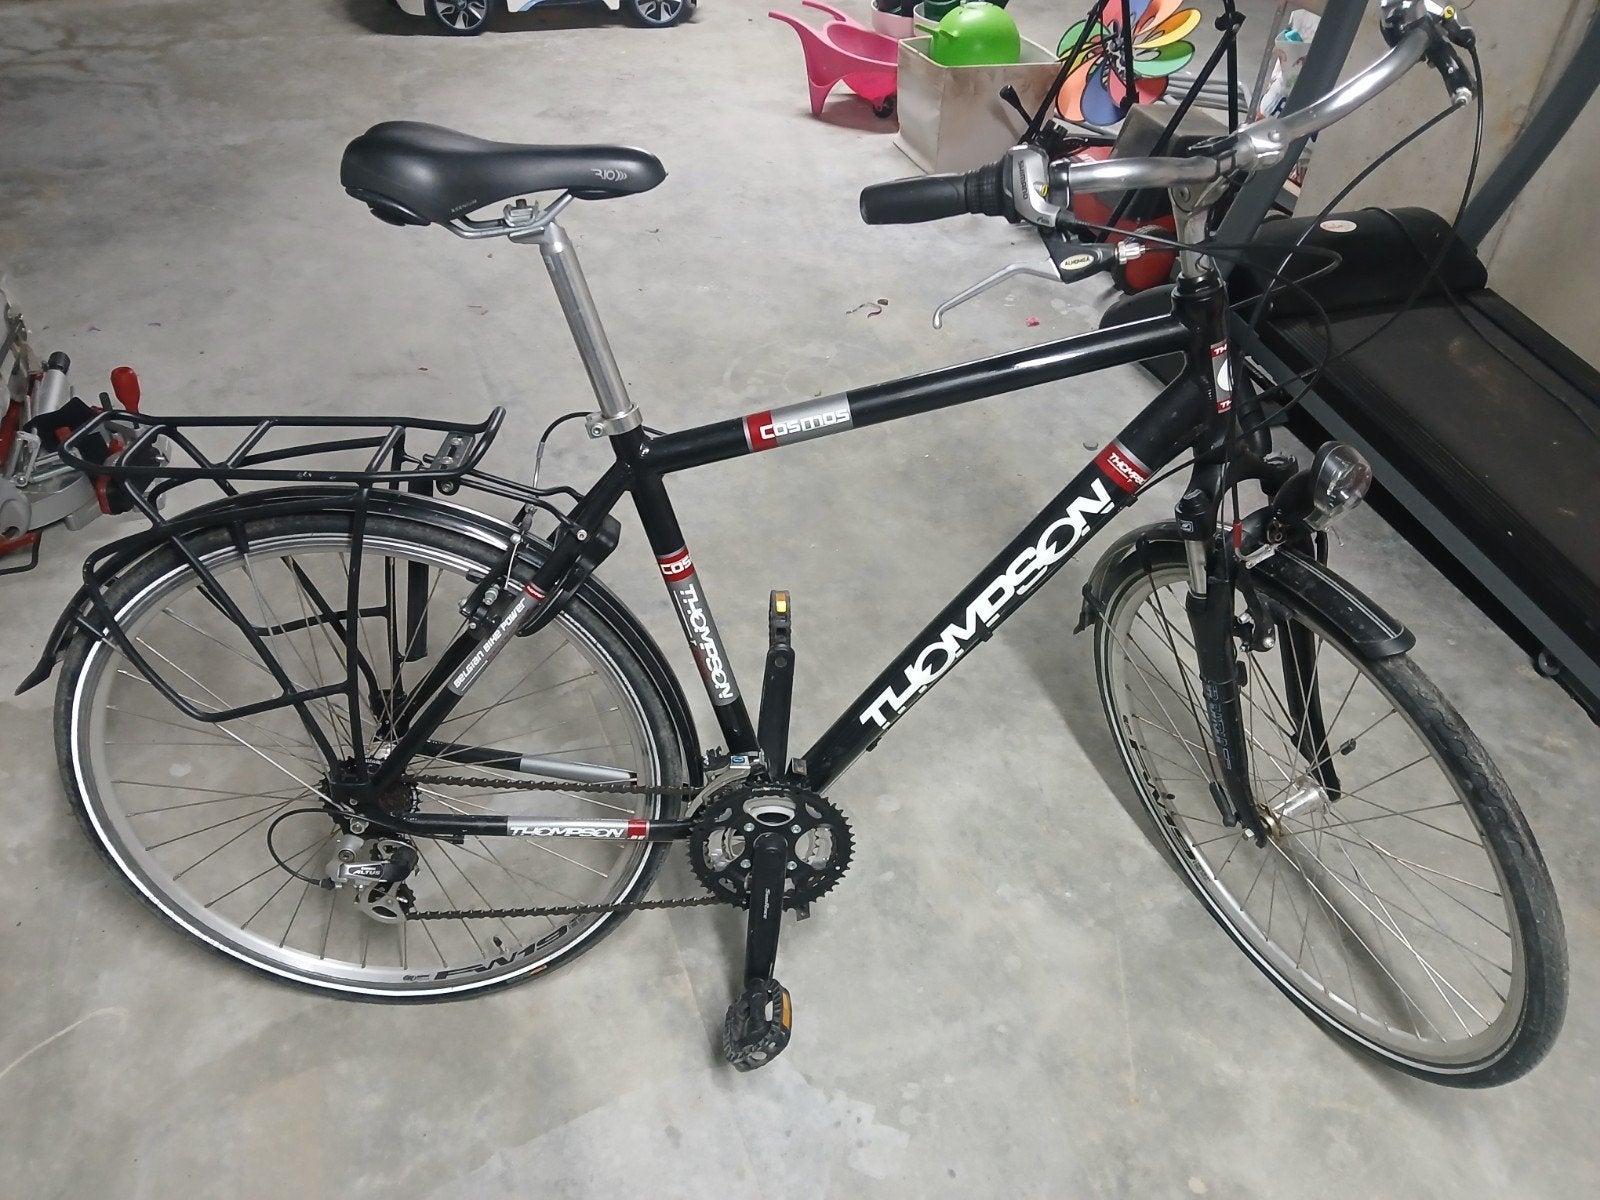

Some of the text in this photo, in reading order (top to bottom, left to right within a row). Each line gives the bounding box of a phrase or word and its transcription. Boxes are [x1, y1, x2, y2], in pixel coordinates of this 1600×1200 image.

[680, 584, 734, 699] THOMPSON
[859, 478, 1115, 730] THOMPSON
[510, 827, 625, 838] THOMPSON
